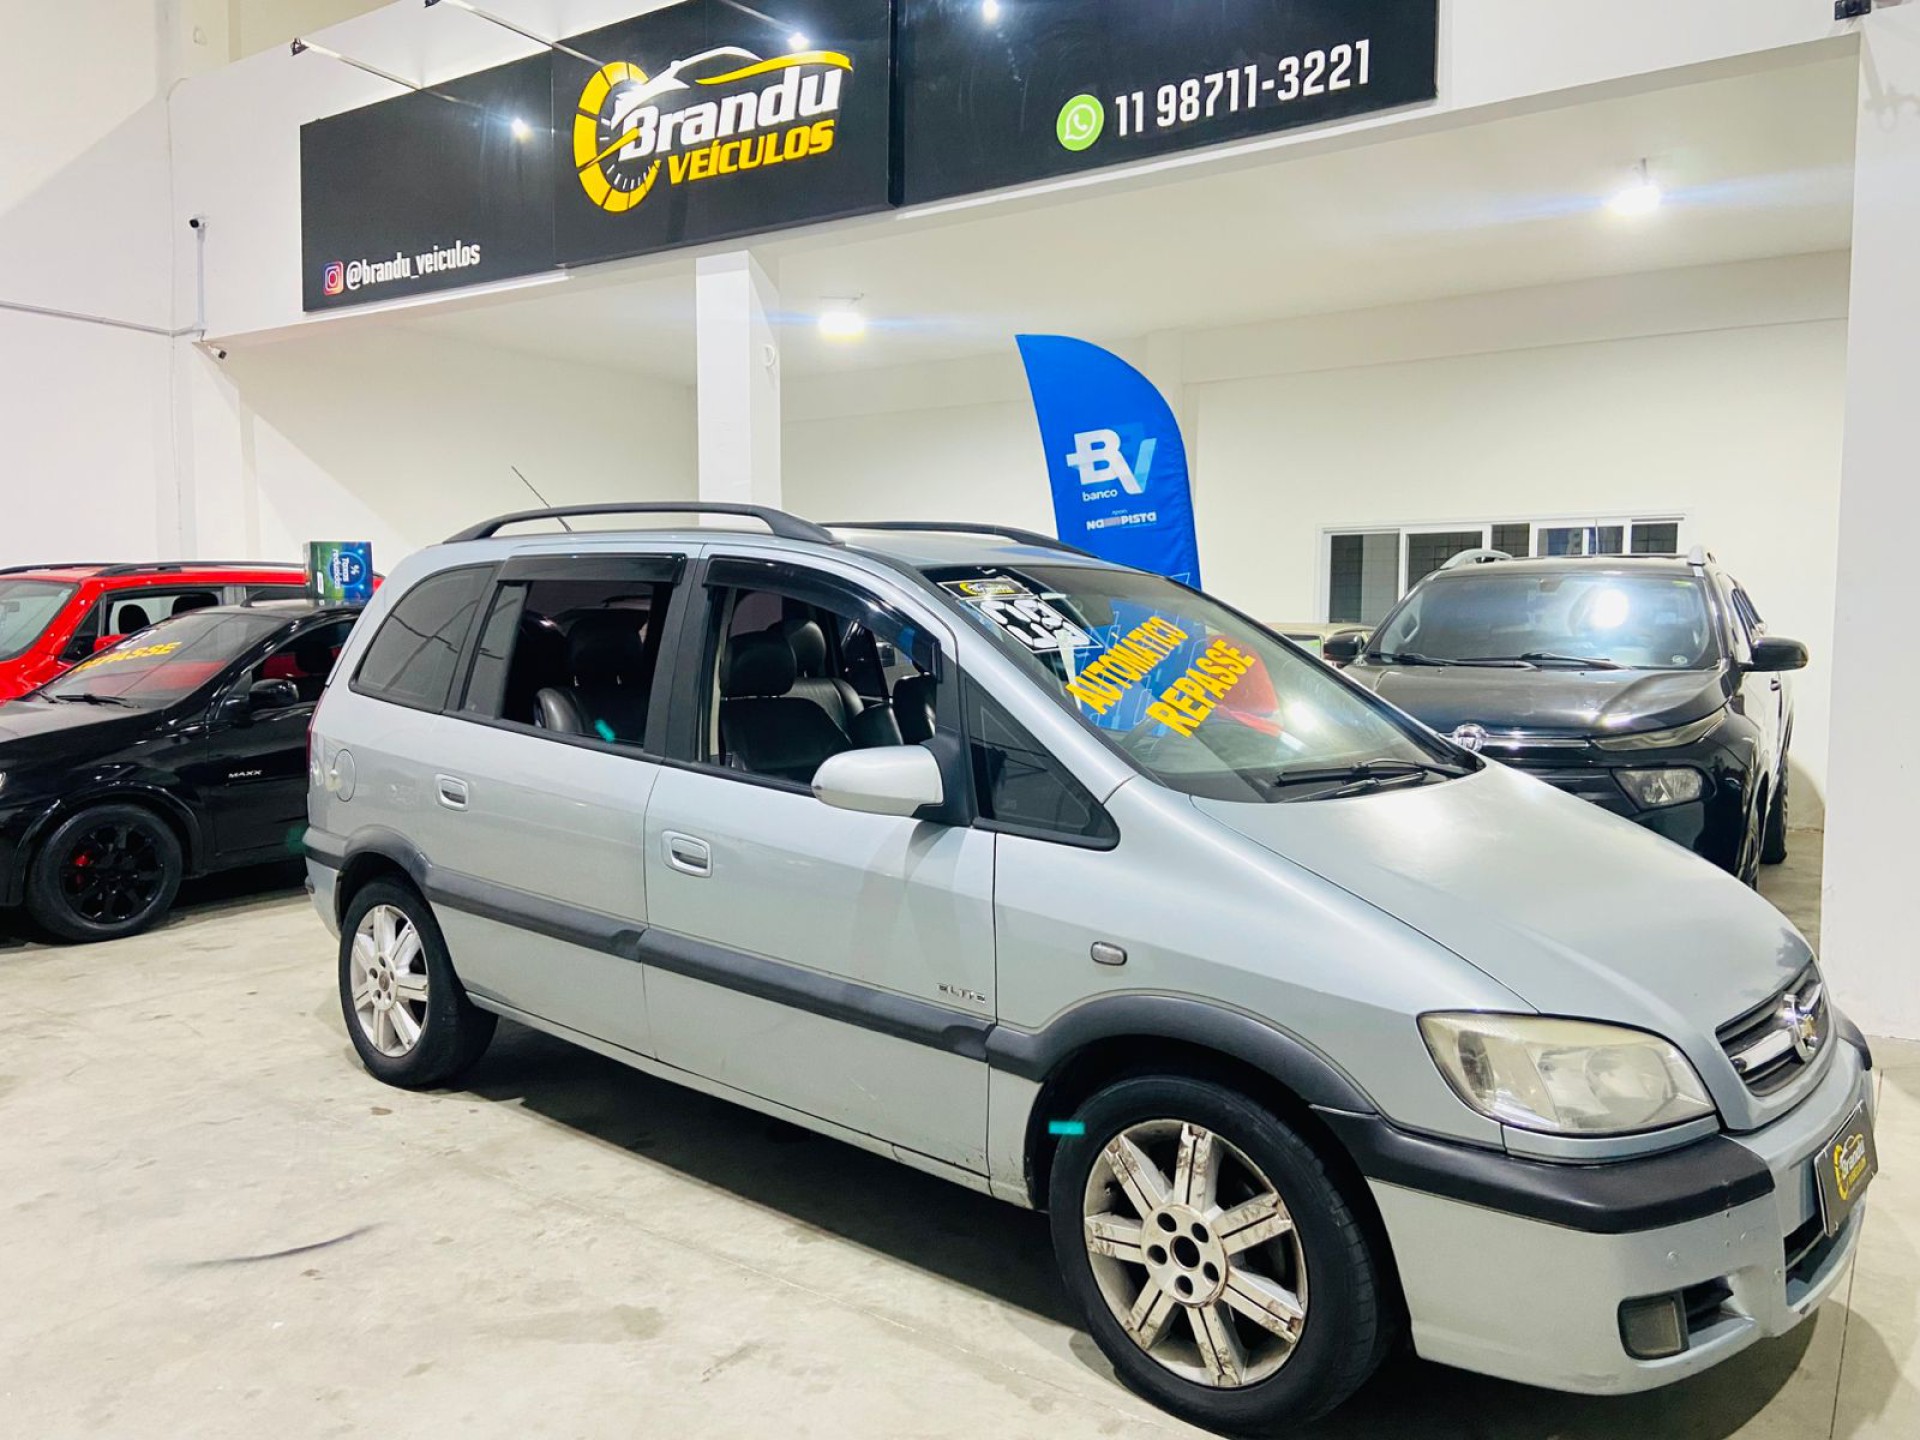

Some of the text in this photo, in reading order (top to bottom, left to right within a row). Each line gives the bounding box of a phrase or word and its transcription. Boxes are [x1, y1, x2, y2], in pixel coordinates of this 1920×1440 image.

[611, 66, 842, 162] Brandu
[1115, 39, 1370, 137] 11 98711-3221
[667, 119, 835, 185] VEÍCULOS
[346, 239, 481, 290] @brandu_veiculos
[1082, 489, 1118, 502] banco
[1146, 639, 1256, 738] REPASSE
[228, 769, 262, 779] MAXX
[936, 983, 986, 1004] ELITE
